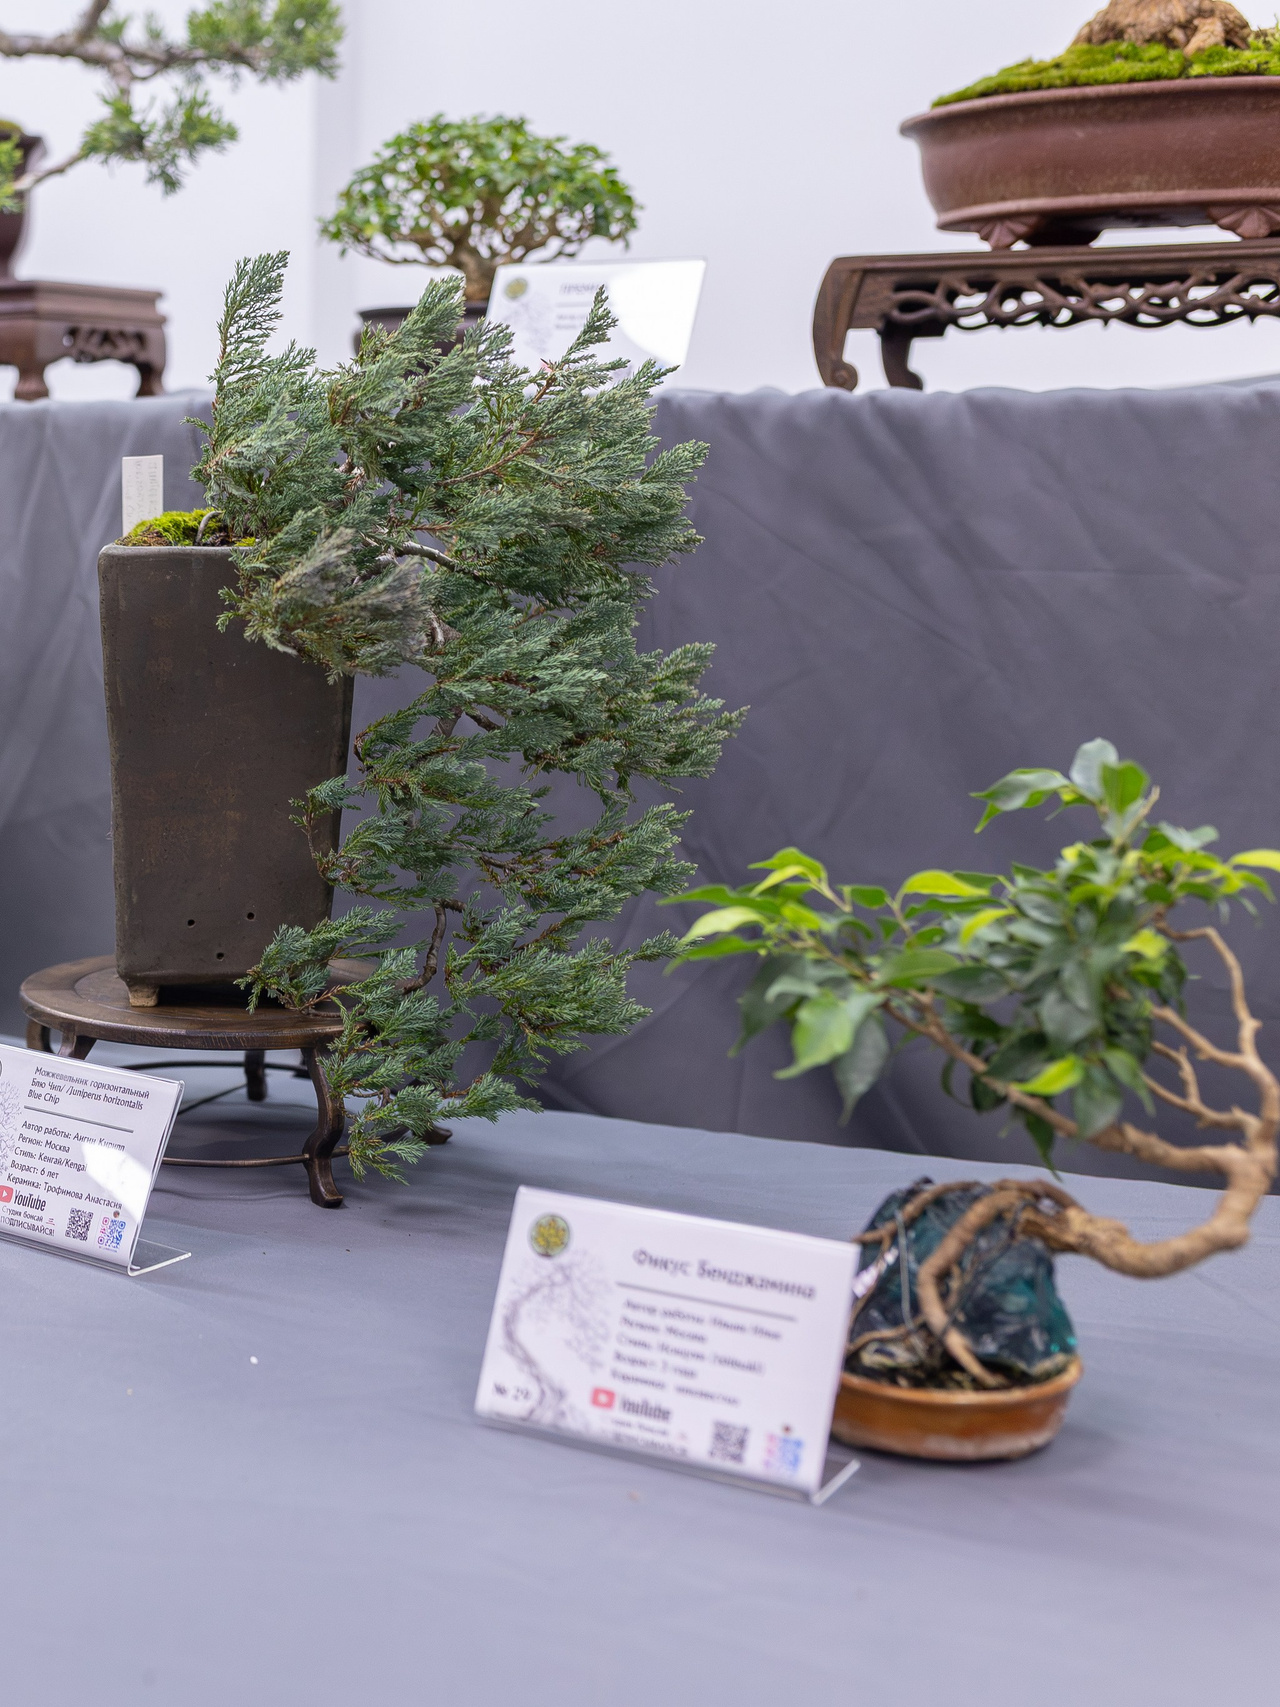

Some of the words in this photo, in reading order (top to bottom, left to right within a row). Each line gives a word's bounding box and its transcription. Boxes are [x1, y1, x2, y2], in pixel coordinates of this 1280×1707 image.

[35, 1066, 88, 1086] Можжевельник
[90, 1080, 150, 1099] горизонтальный
[28, 1089, 42, 1101] Blue
[43, 1093, 60, 1105] Chip
[31, 1078, 46, 1089] Блю
[103, 1093, 143, 1110] horizontalis
[22, 1121, 42, 1134] Автор
[44, 1128, 71, 1140] работы:
[14, 1146, 36, 1158] Стиль:
[18, 1133, 42, 1147] Регион:
[45, 1140, 70, 1153] Москва
[11, 1160, 38, 1174] Возраст:
[47, 1170, 59, 1179] лет
[7, 1173, 41, 1189] Керамика:
[44, 1182, 83, 1200] Трофимова
[85, 1193, 122, 1209] Анастасия
[14, 1190, 46, 1211] YouTube
[2, 1205, 22, 1217] Студия
[23, 1210, 43, 1222] бонсай
[0, 1216, 54, 1237] ПОДПИСЫВАЙСЯ!
[632, 1248, 691, 1277] Фикус
[696, 1258, 817, 1299] Бенджамина
